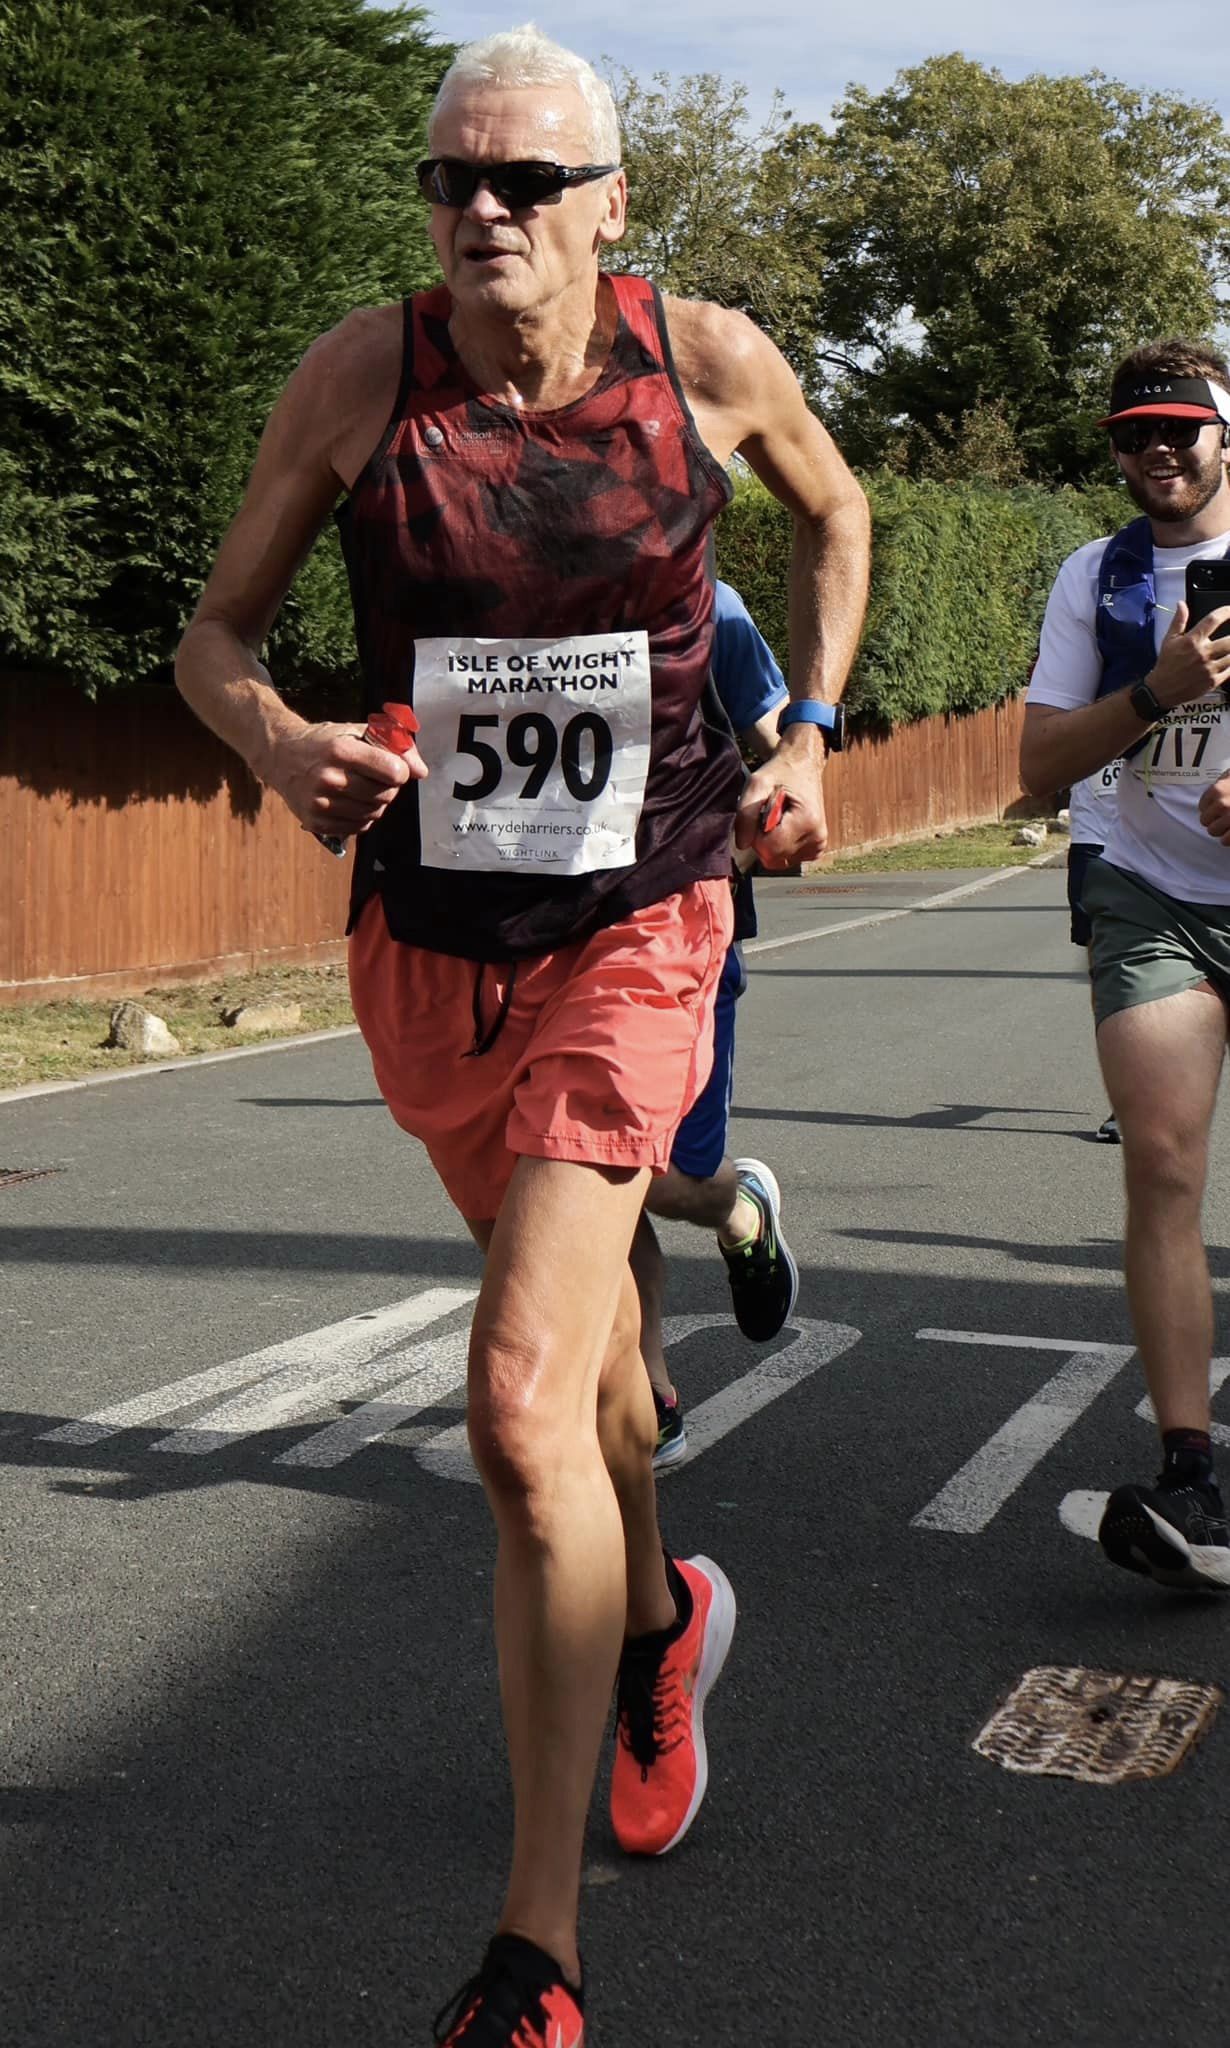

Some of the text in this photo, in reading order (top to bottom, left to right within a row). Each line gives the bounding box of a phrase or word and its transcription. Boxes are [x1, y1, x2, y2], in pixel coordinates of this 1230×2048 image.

[455, 432, 492, 440] LONDON
[448, 651, 635, 672] ISLE OF WIGHT
[468, 673, 618, 694] MARATHON
[452, 711, 613, 801] 590
[1151, 727, 1211, 767] 717
[453, 821, 608, 837] www.rydeharriers.co.uk
[498, 847, 559, 859] WIGHTLINK
